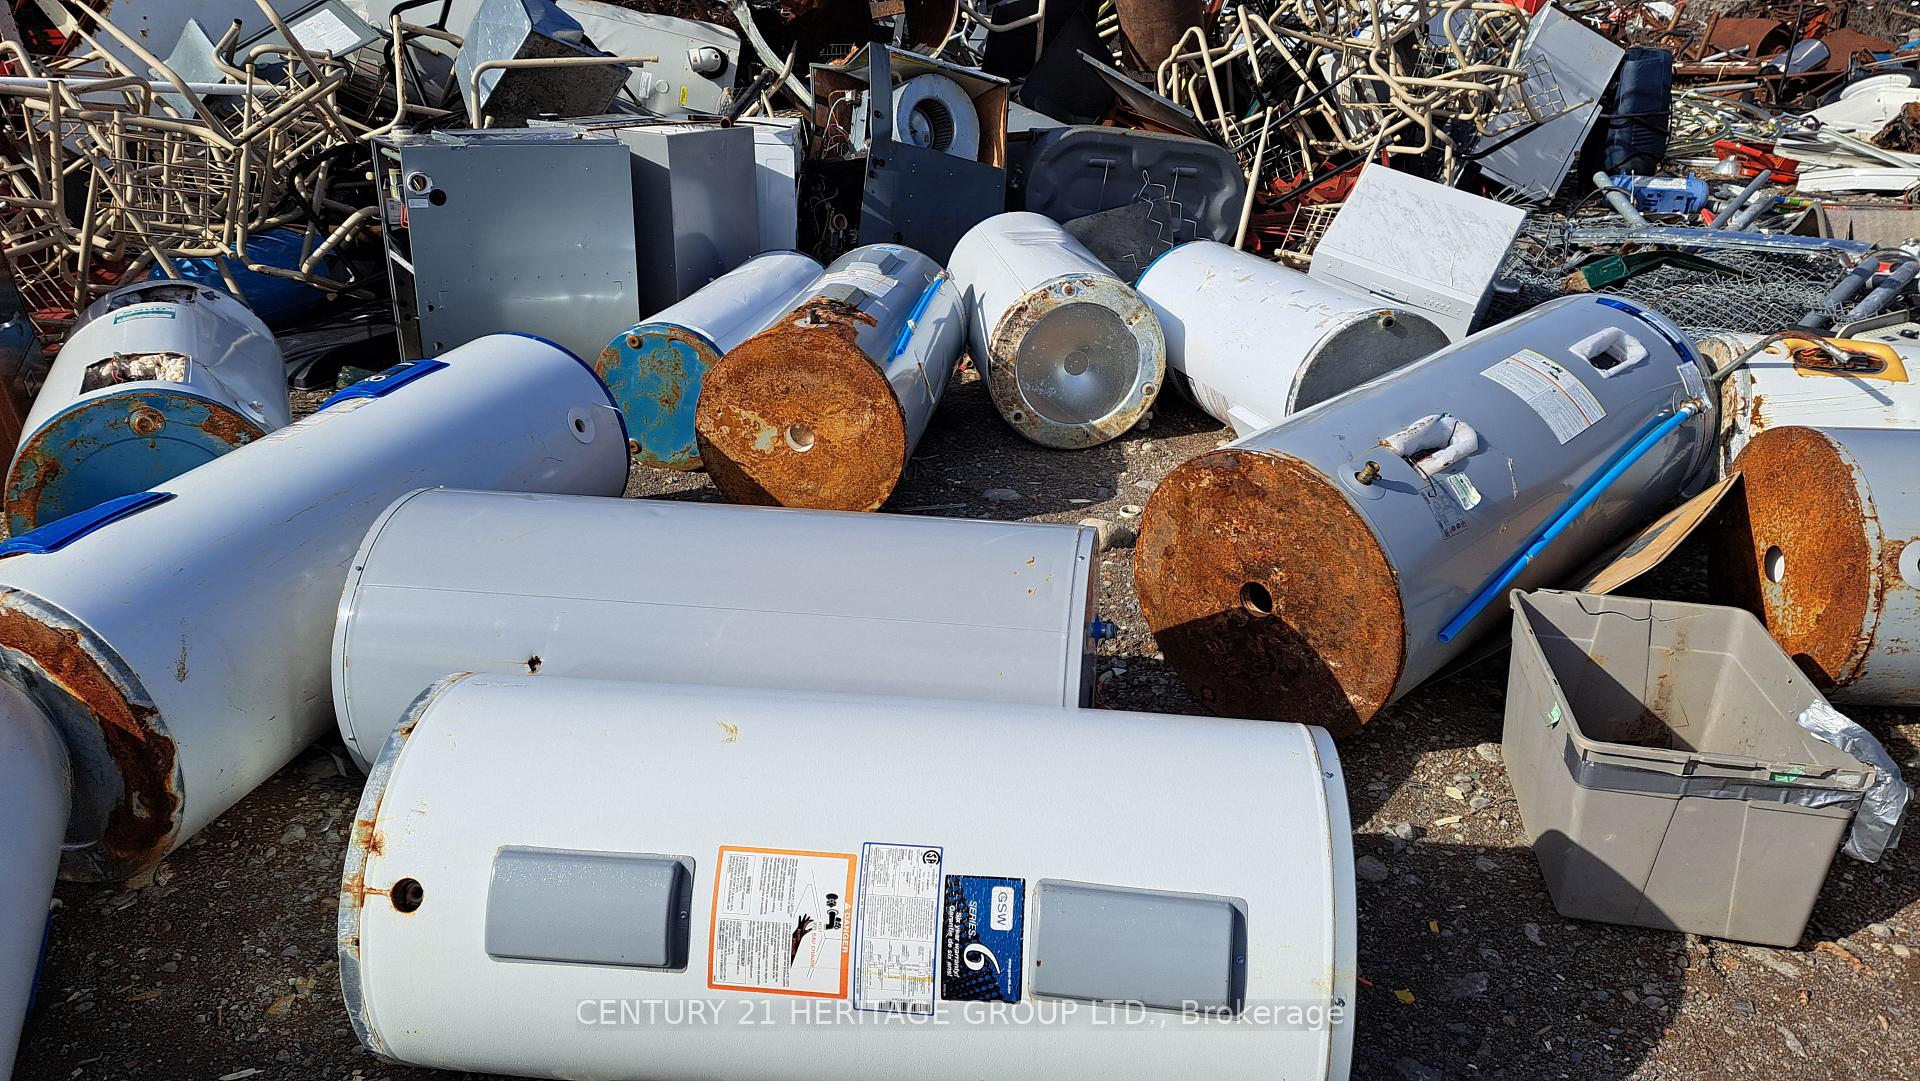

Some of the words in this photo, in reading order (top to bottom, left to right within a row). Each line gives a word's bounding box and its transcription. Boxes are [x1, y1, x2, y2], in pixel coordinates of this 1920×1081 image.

[968, 901, 978, 936] SERIES
[996, 892, 1008, 926] GSW
[841, 912, 851, 953] DANGER
[964, 943, 1000, 975] 6
